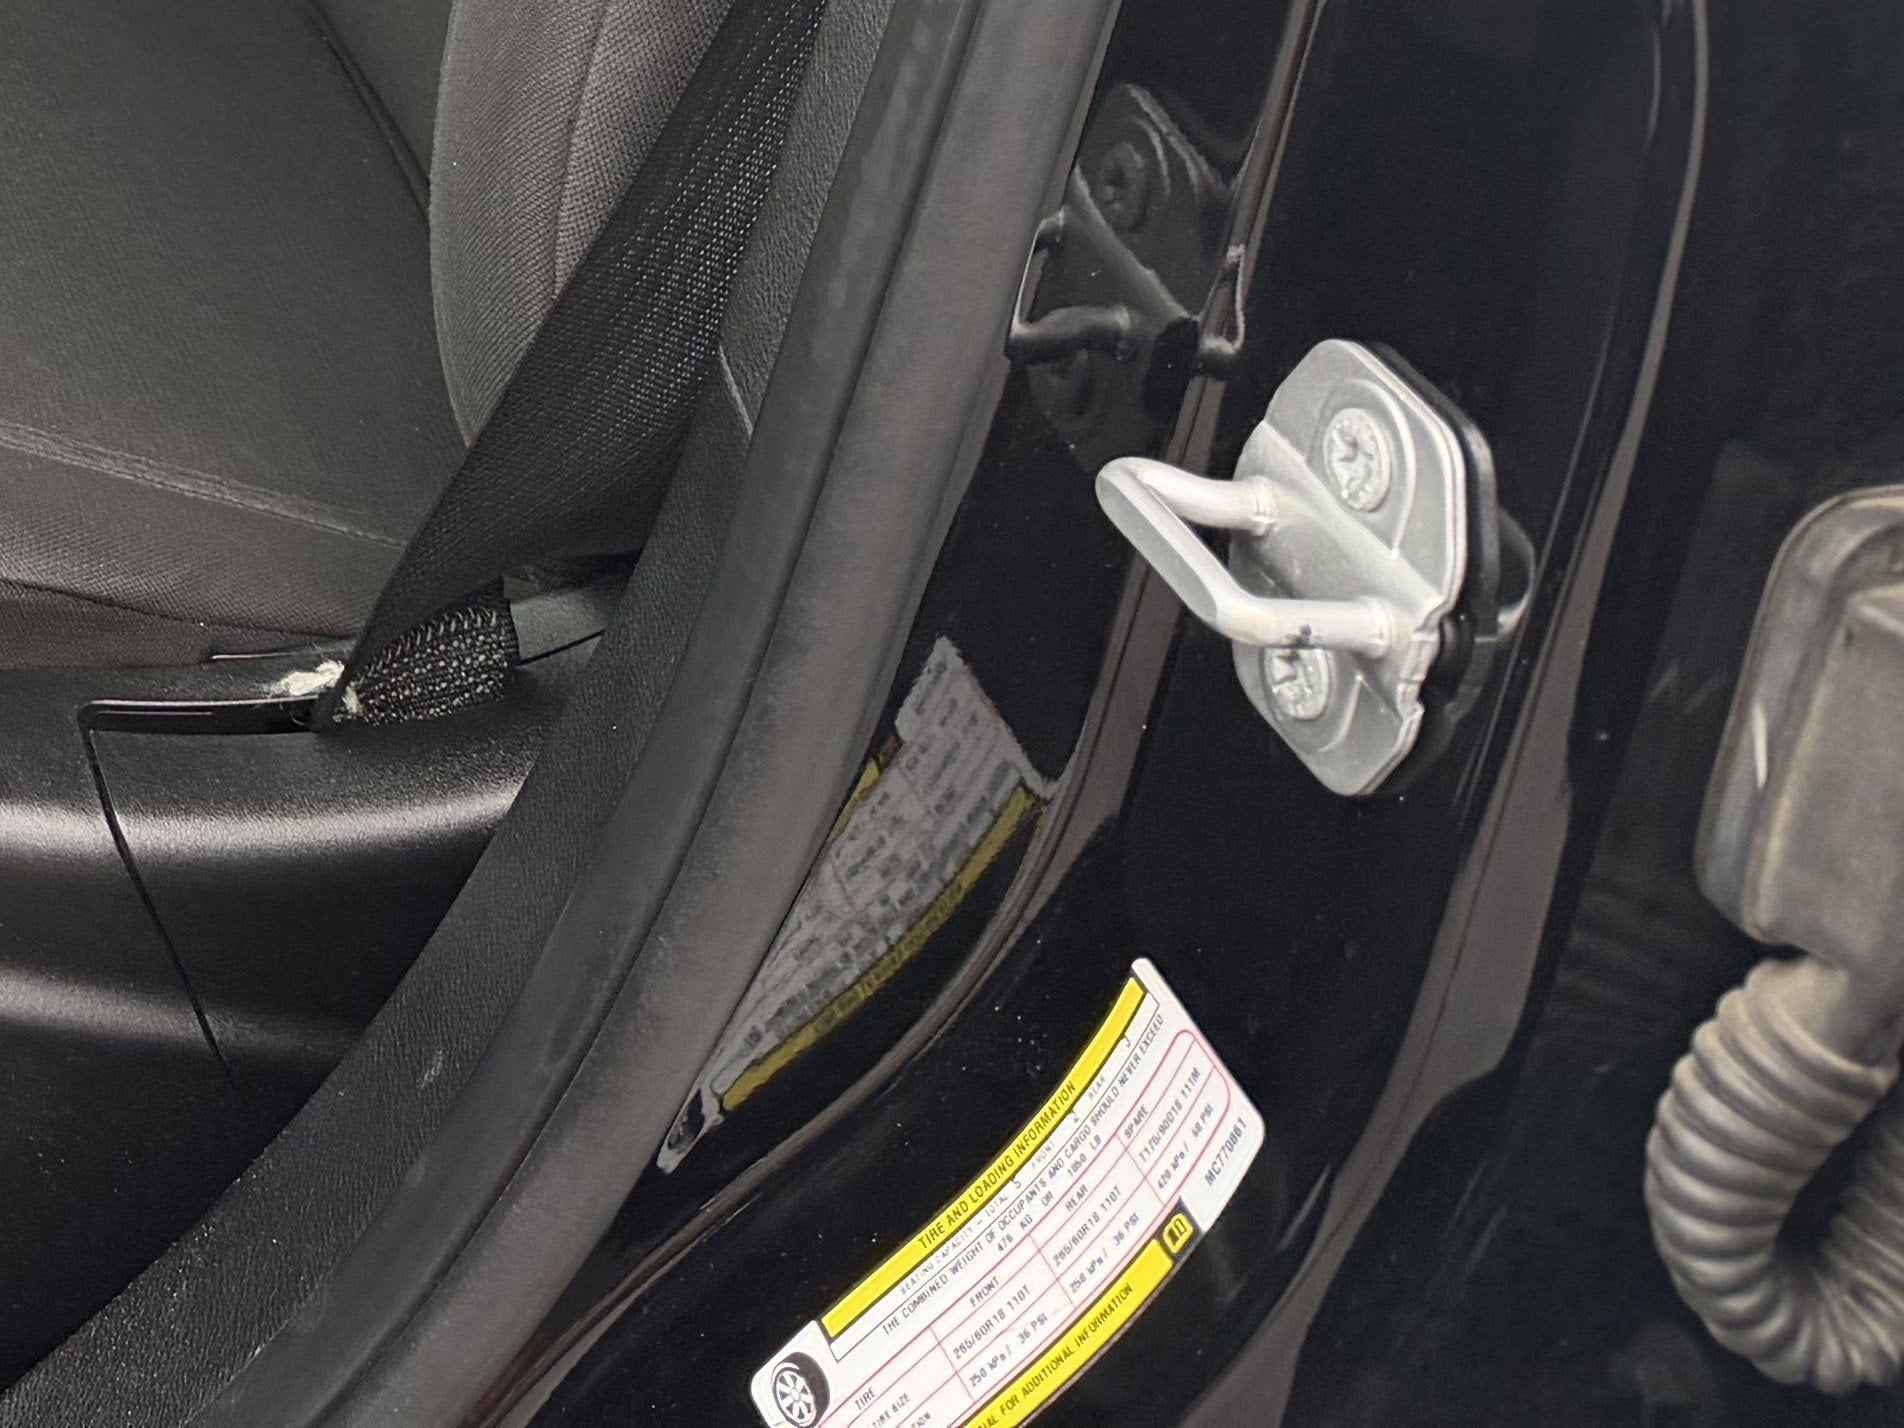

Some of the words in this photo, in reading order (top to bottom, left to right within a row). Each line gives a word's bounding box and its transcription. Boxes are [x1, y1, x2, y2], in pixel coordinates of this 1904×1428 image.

[882, 1316, 901, 1335] THE
[902, 1276, 949, 1318] COMBINED
[950, 1242, 984, 1276] WEIGHT
[985, 1228, 997, 1244] OF
[998, 1178, 1047, 1231] OCCUPANTS
[1048, 1159, 1064, 1179] AND
[1064, 1126, 1091, 1162] CARGO
[1090, 1087, 1119, 1127] SHOULD
[1118, 1053, 1141, 1089] NEVER
[1140, 1014, 1164, 1055] EXCEED
[919, 1221, 945, 1249] TIRE
[946, 1200, 970, 1227] AND
[971, 1155, 1015, 1207] LOADING
[1015, 1081, 1076, 1158] INFORMATION
[854, 1386, 877, 1410] TIRE
[970, 1276, 1000, 1307] FRONT
[1000, 1394, 1021, 1416] FOR
[1022, 1346, 1075, 1399] ADDITIONAL
[1074, 1282, 1134, 1348] INFORMATION
